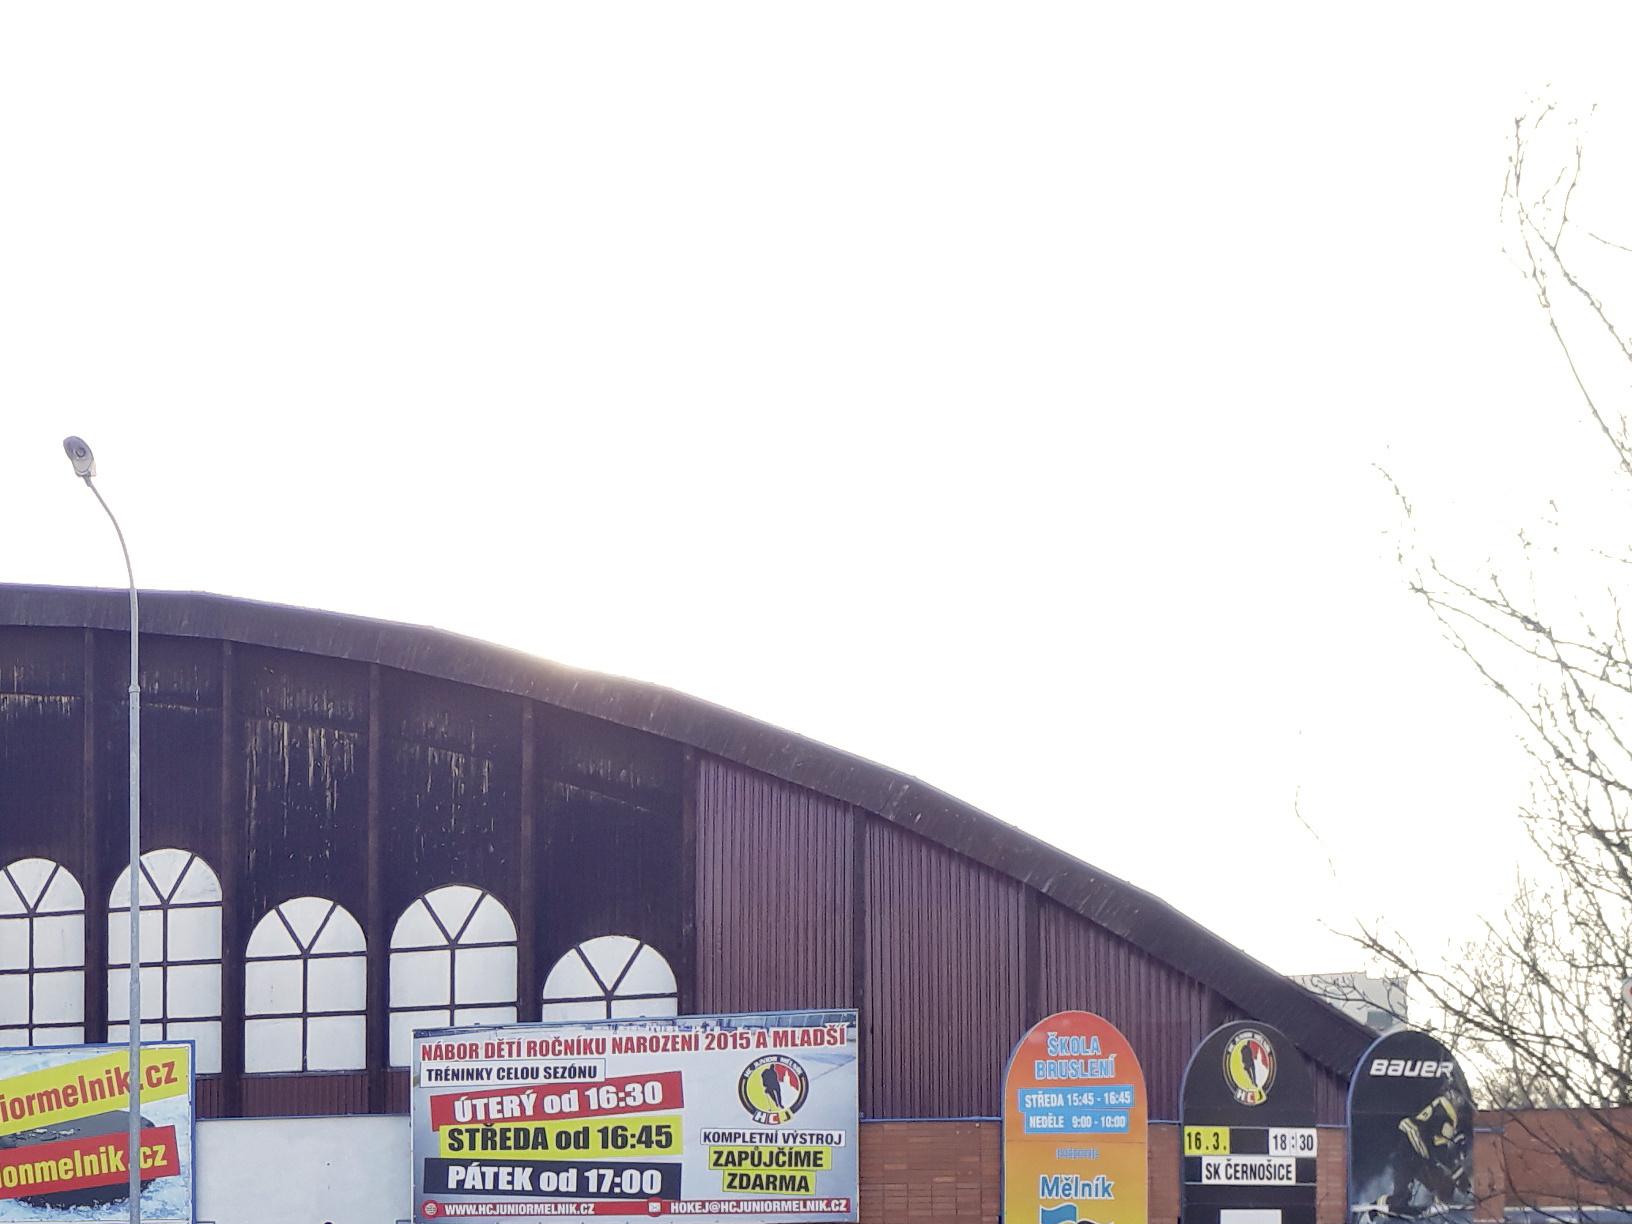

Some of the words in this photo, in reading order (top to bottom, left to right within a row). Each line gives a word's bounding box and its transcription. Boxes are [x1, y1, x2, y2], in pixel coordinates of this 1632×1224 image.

[421, 1039, 479, 1061] NÁBOR
[484, 1036, 522, 1059] DĚTÍ
[526, 1033, 606, 1058] ROČNÍKU
[611, 1029, 700, 1056] NAROZENÍ
[704, 1030, 751, 1052] 2015
[755, 1030, 768, 1050] A
[772, 1023, 846, 1048] MLADŠÍ
[1047, 1031, 1100, 1056] ŠKOLA
[426, 1064, 492, 1082] TRÉNINKY
[496, 1066, 541, 1082] CELOU
[543, 1063, 597, 1080] SEZÓNU
[1035, 1053, 1117, 1080] BRUSLENÍ
[453, 1089, 539, 1124] ÚTERÝ
[543, 1087, 581, 1115] od
[584, 1080, 663, 1113] 16:30
[1025, 1092, 1064, 1108] STŘEDA
[1067, 1093, 1095, 1106] 15:45
[1102, 1091, 1131, 1105] 16:45
[1029, 1113, 1065, 1129] NEDĚLE
[1071, 1115, 1093, 1129] 9:00
[1100, 1115, 1127, 1129] 10:00
[447, 1119, 549, 1152] STŘEDA
[555, 1126, 590, 1150] od
[596, 1124, 673, 1151] 16:45
[702, 1129, 780, 1145] KOMPLETNÍ
[782, 1129, 843, 1146] VÝSTROJ
[1272, 1133, 1314, 1151] 18:30
[712, 1146, 824, 1169] ZAPŮJČÍME
[447, 1162, 536, 1192] PÁTEK
[539, 1167, 579, 1193] od
[584, 1167, 663, 1195] 17:00
[1205, 1163, 1221, 1181] SK
[1224, 1158, 1293, 1182] ČERNOŠICE
[726, 1172, 810, 1193] ZDARMA
[1039, 1175, 1115, 1200] Mělník
[445, 1201, 595, 1216] WWW.HCJUNIORMELNIK.CZ
[670, 1198, 848, 1215] HOKEJ@HCJUNIORMELNIK.CZ
